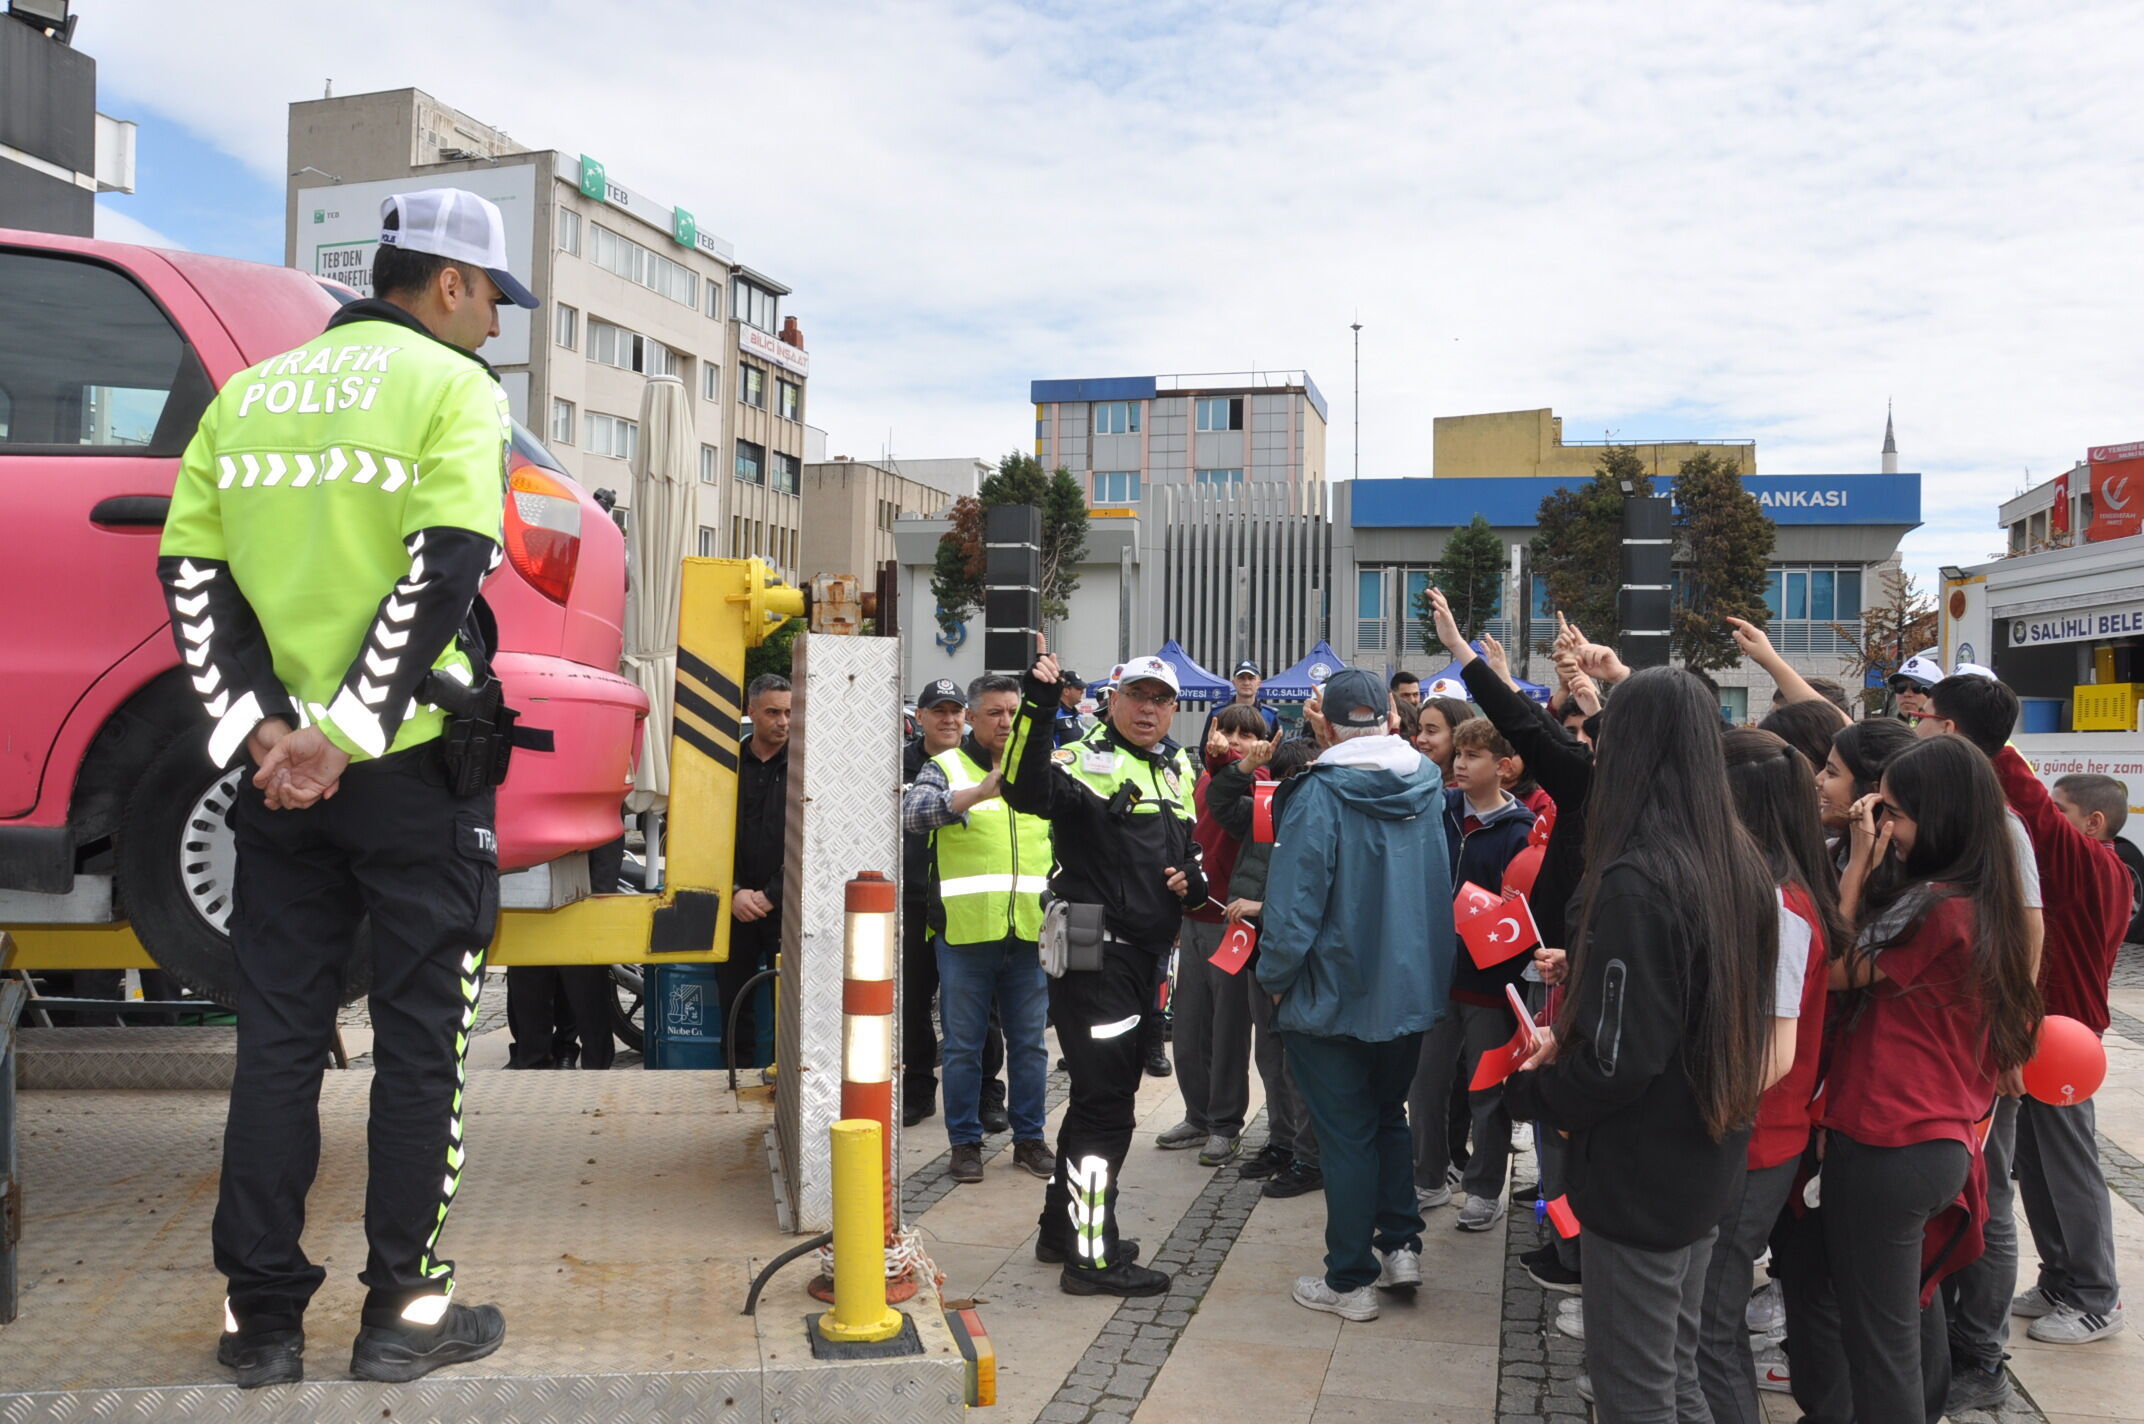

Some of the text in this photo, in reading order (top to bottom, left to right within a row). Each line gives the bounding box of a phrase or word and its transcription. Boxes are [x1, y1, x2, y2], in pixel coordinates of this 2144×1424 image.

[605, 182, 629, 206] TEB
[694, 231, 715, 251] TEB
[322, 249, 362, 270] TEB'DEN
[322, 268, 374, 287] ARİFETLİ
[259, 345, 401, 379] TRAFİK
[238, 375, 382, 418] POLİSİ
[2031, 612, 2143, 642] SALİHLİ BELE
[2043, 758, 2083, 776] günde
[2087, 758, 2110, 774] her
[2113, 763, 2144, 775] zam
